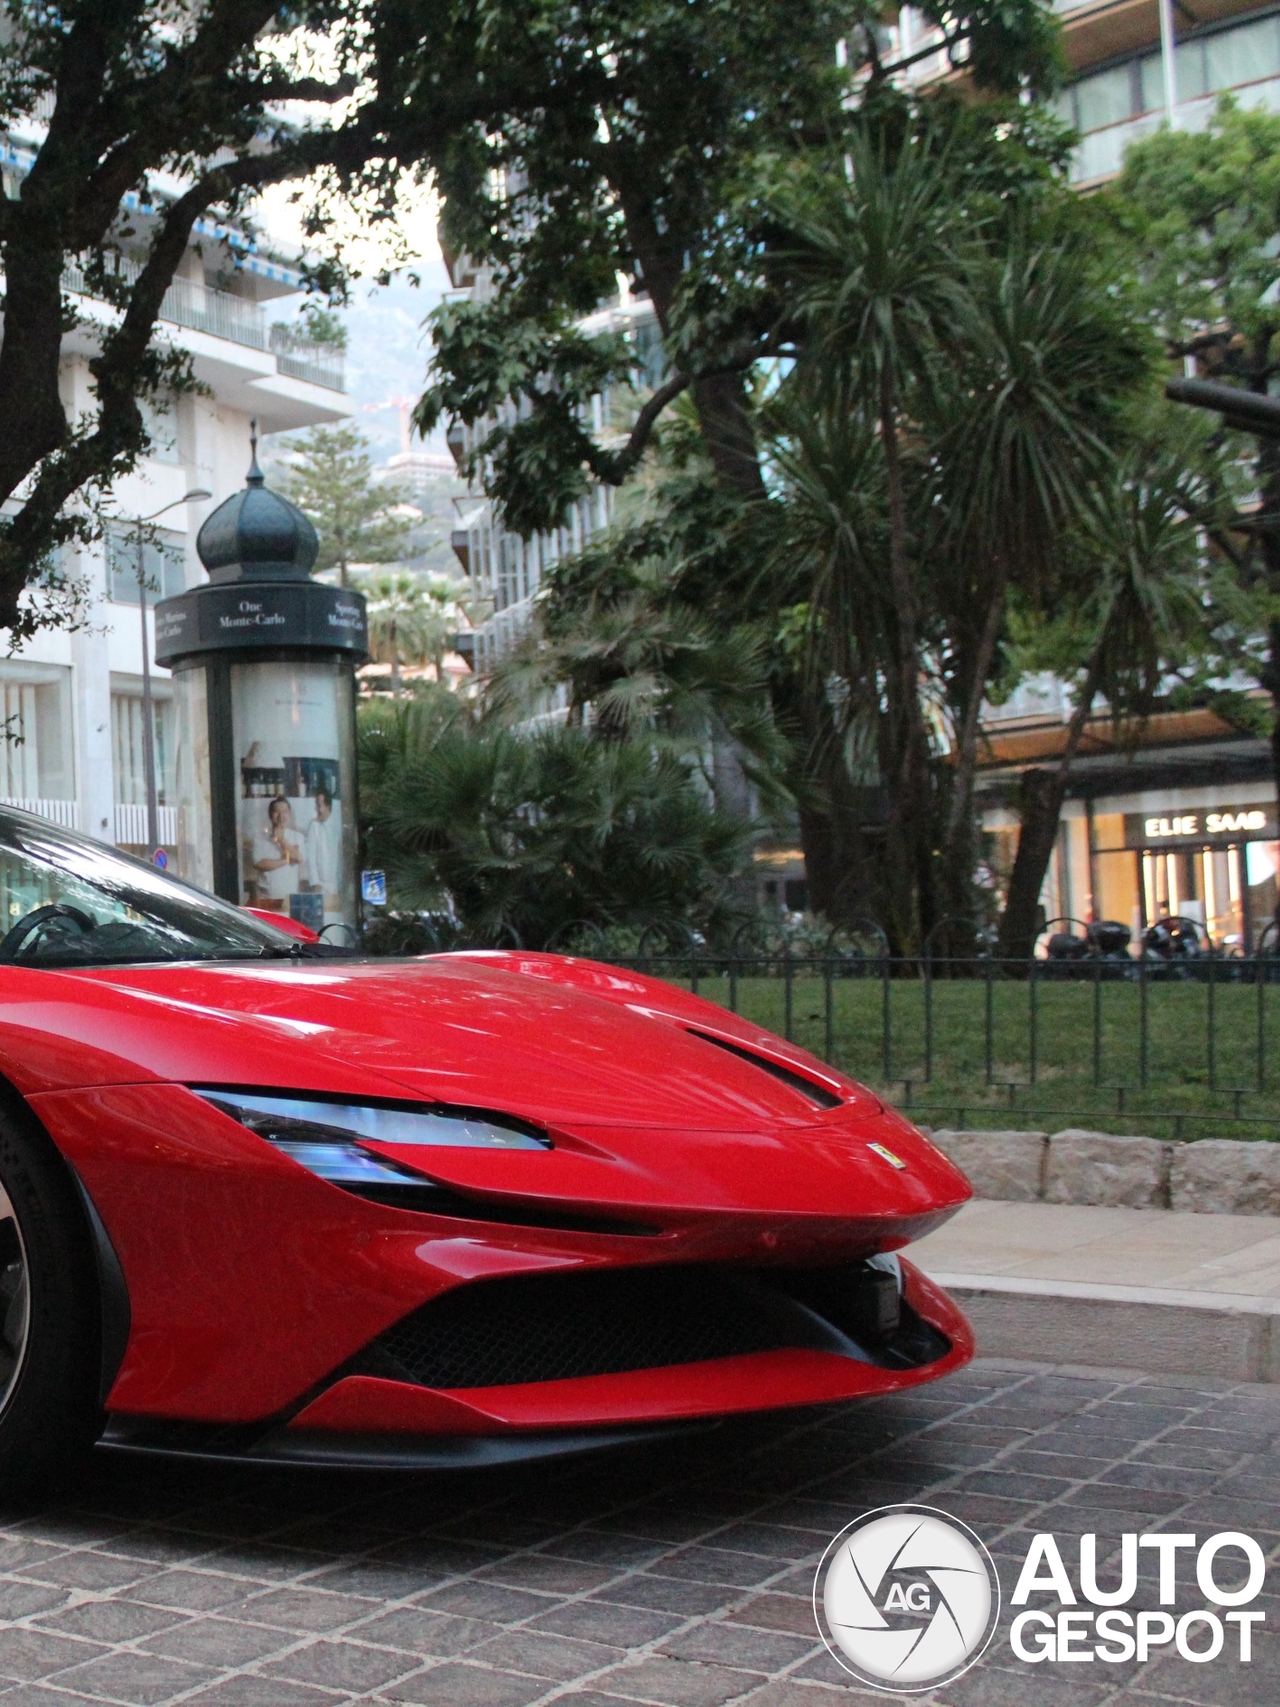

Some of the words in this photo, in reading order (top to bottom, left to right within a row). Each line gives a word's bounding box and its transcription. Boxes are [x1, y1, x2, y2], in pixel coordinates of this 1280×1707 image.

[239, 601, 263, 612] One
[220, 613, 286, 628] Monte-Carlo
[1145, 815, 1199, 838] ELIE
[1205, 810, 1267, 833] SAAB
